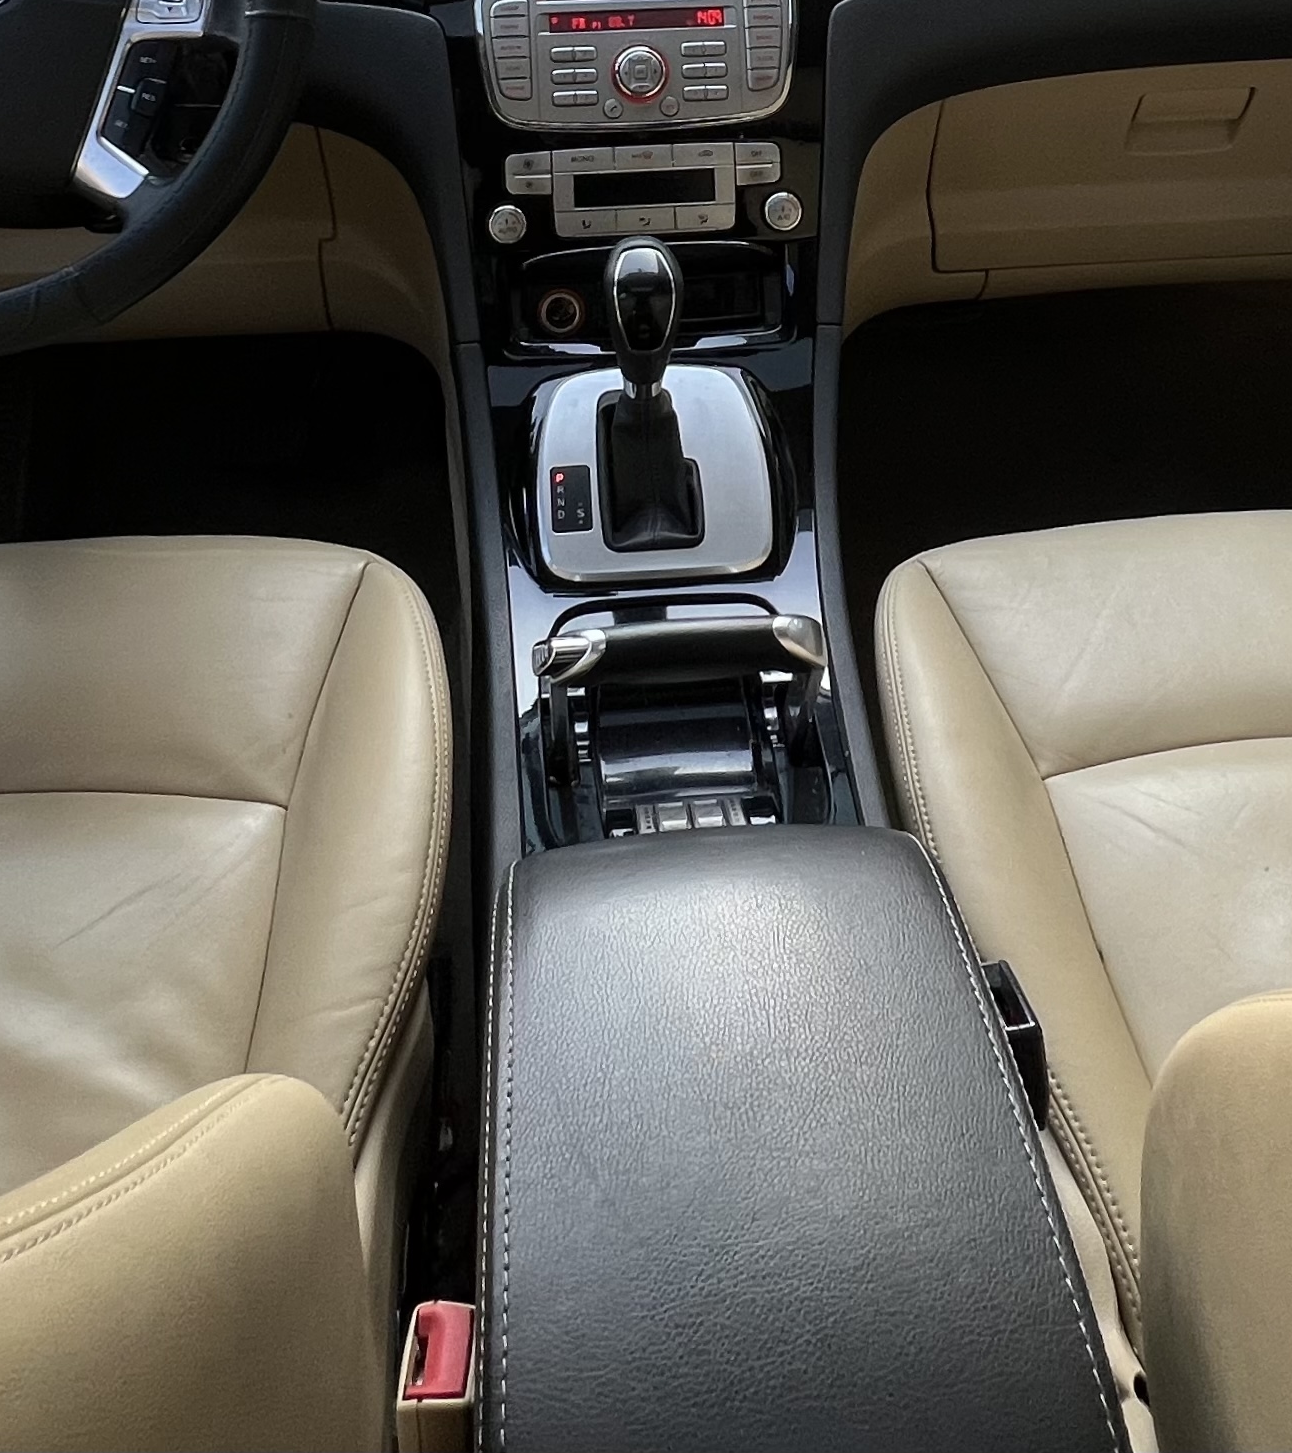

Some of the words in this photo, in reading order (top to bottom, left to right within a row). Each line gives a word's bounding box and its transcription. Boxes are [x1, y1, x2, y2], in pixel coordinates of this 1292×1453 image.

[555, 473, 565, 483] P
[556, 486, 565, 495] R
[557, 499, 566, 507] N
[557, 510, 566, 520] D
[576, 509, 586, 518] S
